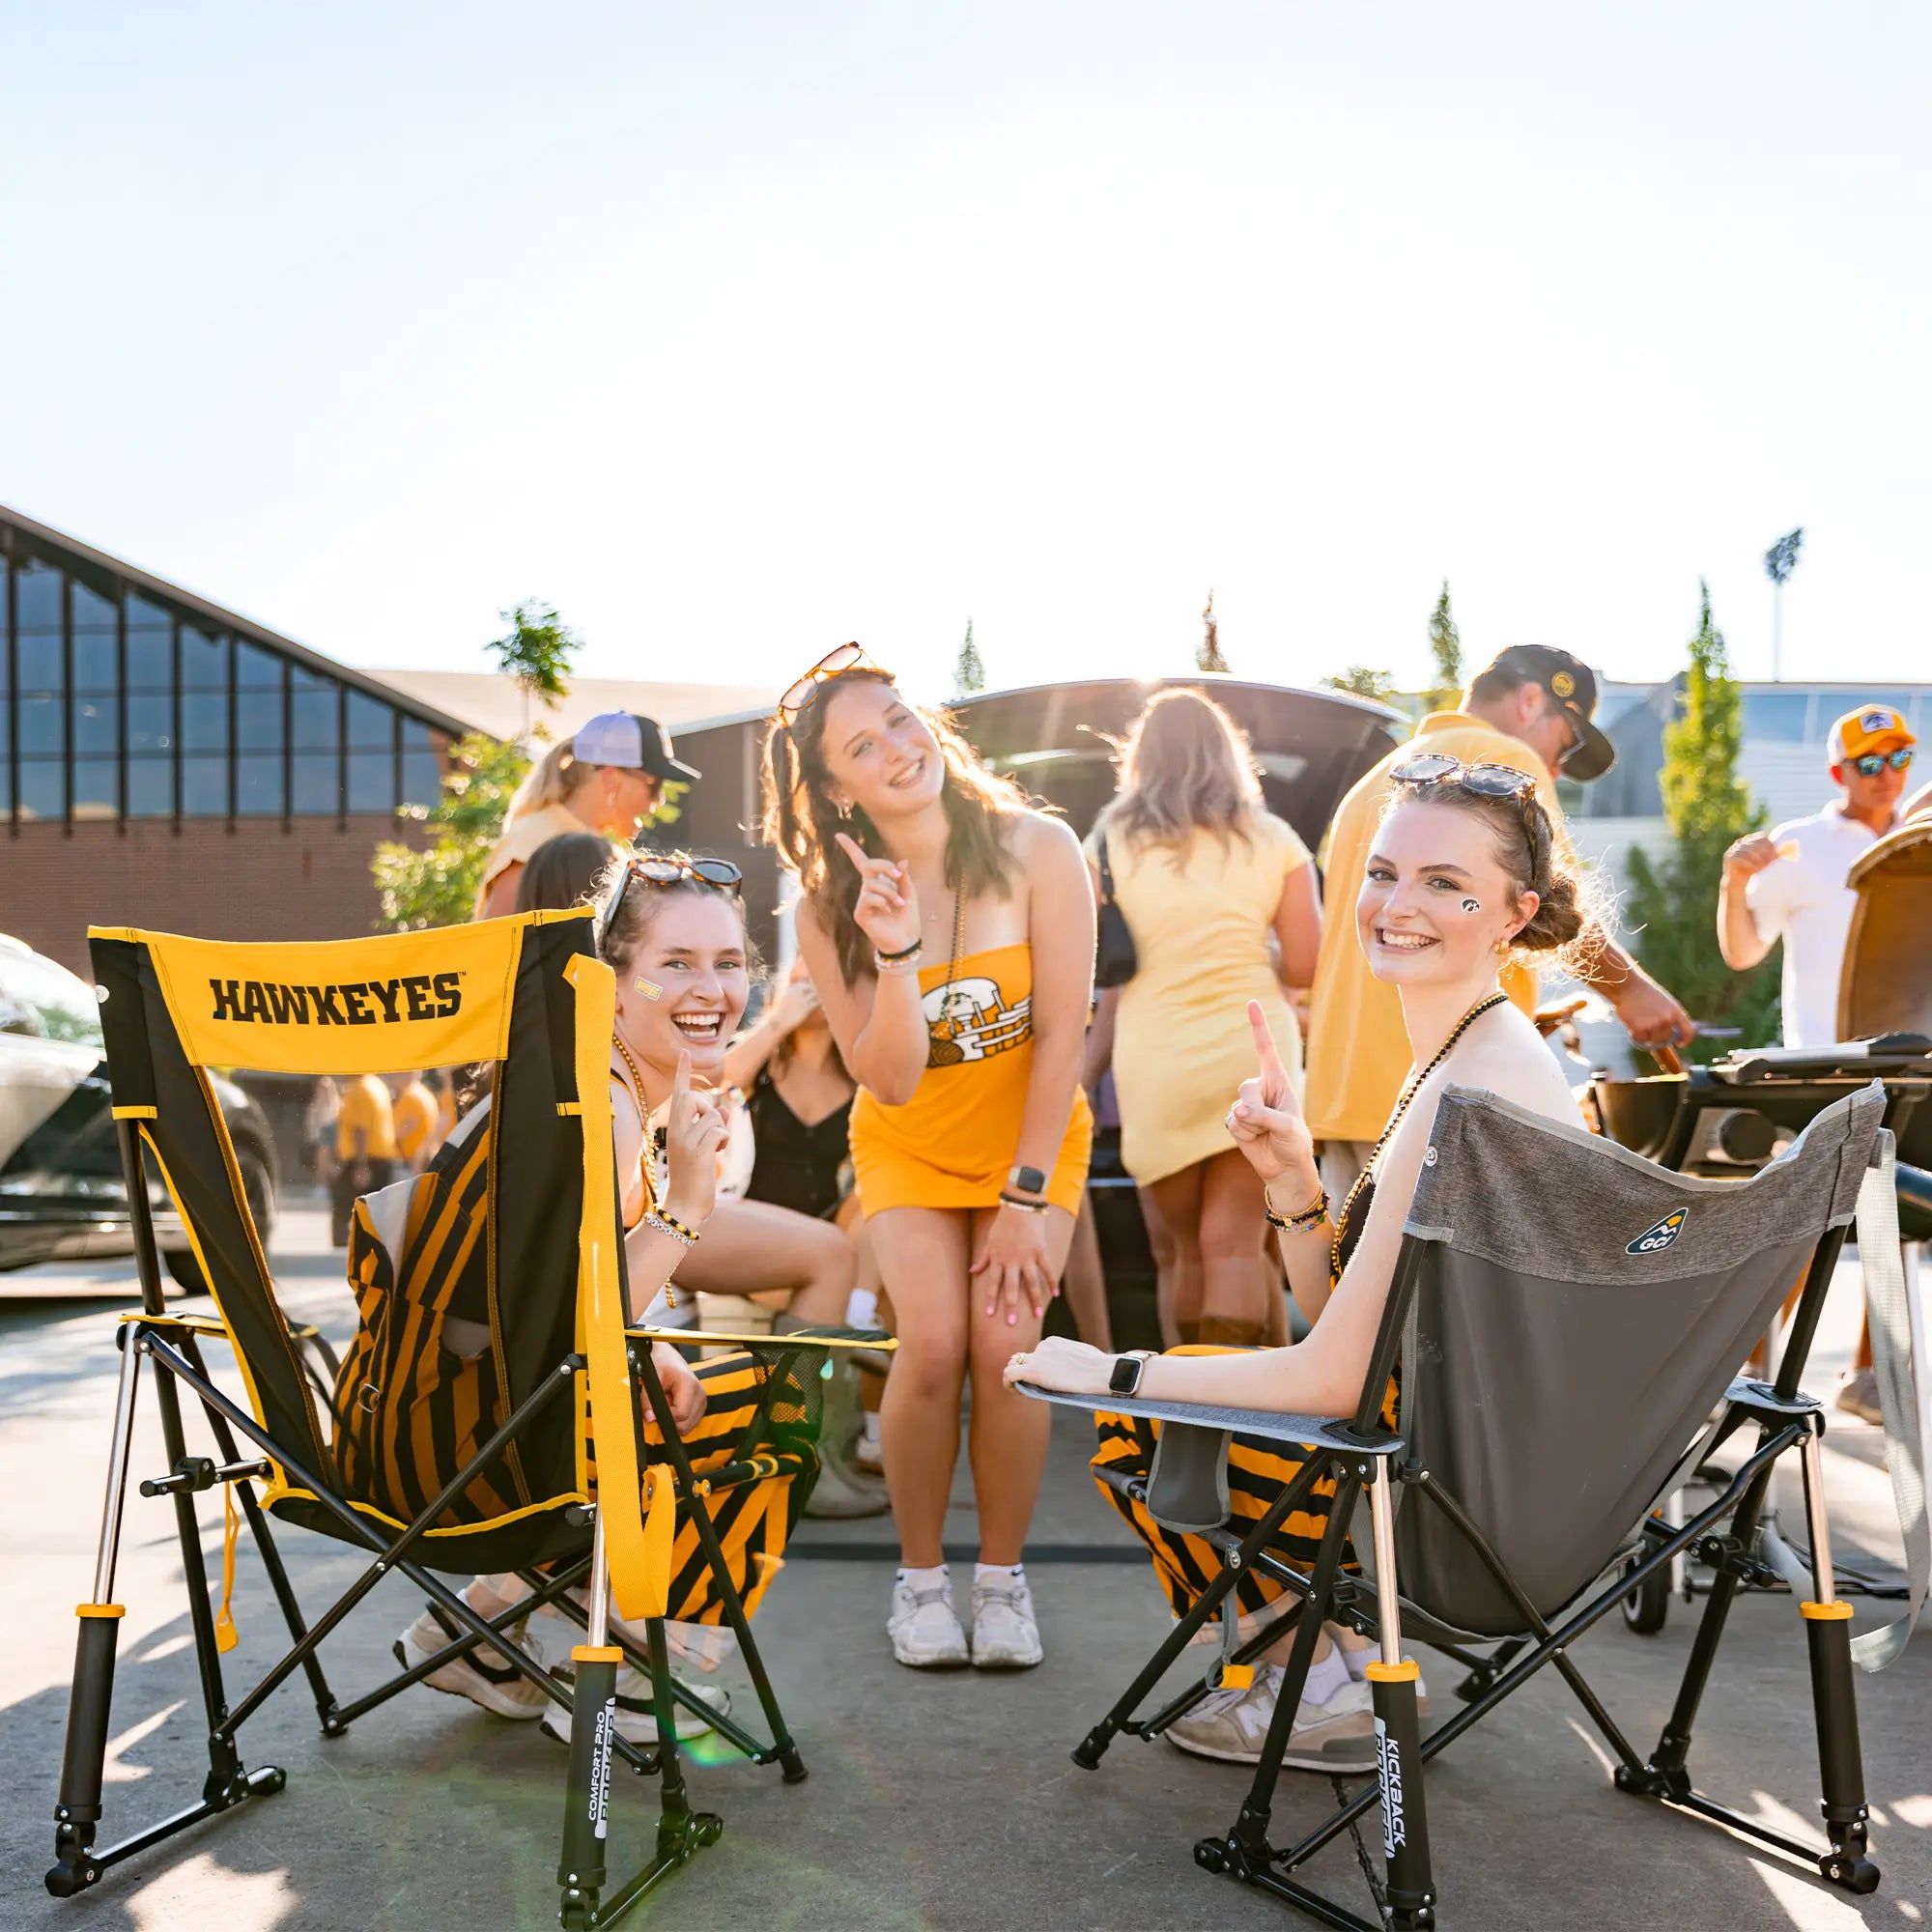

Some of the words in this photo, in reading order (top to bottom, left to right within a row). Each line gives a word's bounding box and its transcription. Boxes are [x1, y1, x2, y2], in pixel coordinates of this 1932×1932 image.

[209, 972, 462, 1025] HAWKEYES
[1639, 1236, 1674, 1251] GCI
[594, 1711, 606, 1745] PRO
[588, 1747, 603, 1821] COMFORT
[1386, 1738, 1406, 1848] KICKBACK
